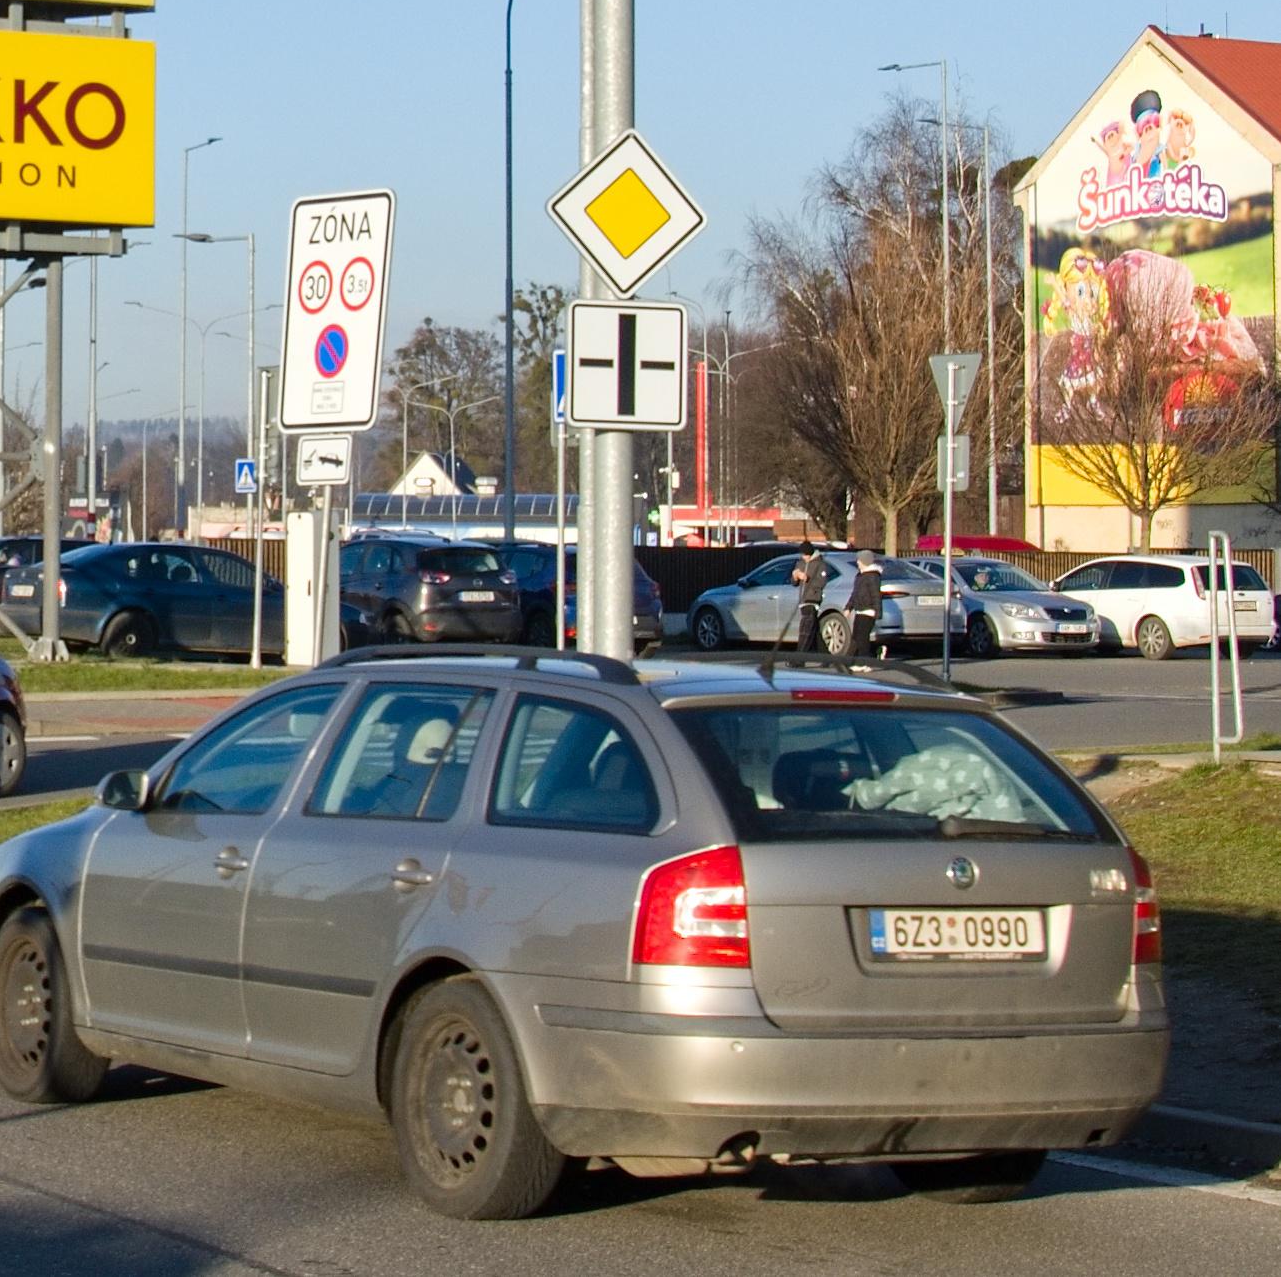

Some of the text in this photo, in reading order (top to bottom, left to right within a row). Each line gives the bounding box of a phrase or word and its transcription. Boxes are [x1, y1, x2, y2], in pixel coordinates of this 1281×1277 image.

[309, 206, 372, 245] ZÓNA
[305, 274, 327, 300] 30
[894, 915, 1028, 947] 6Z3 0990
